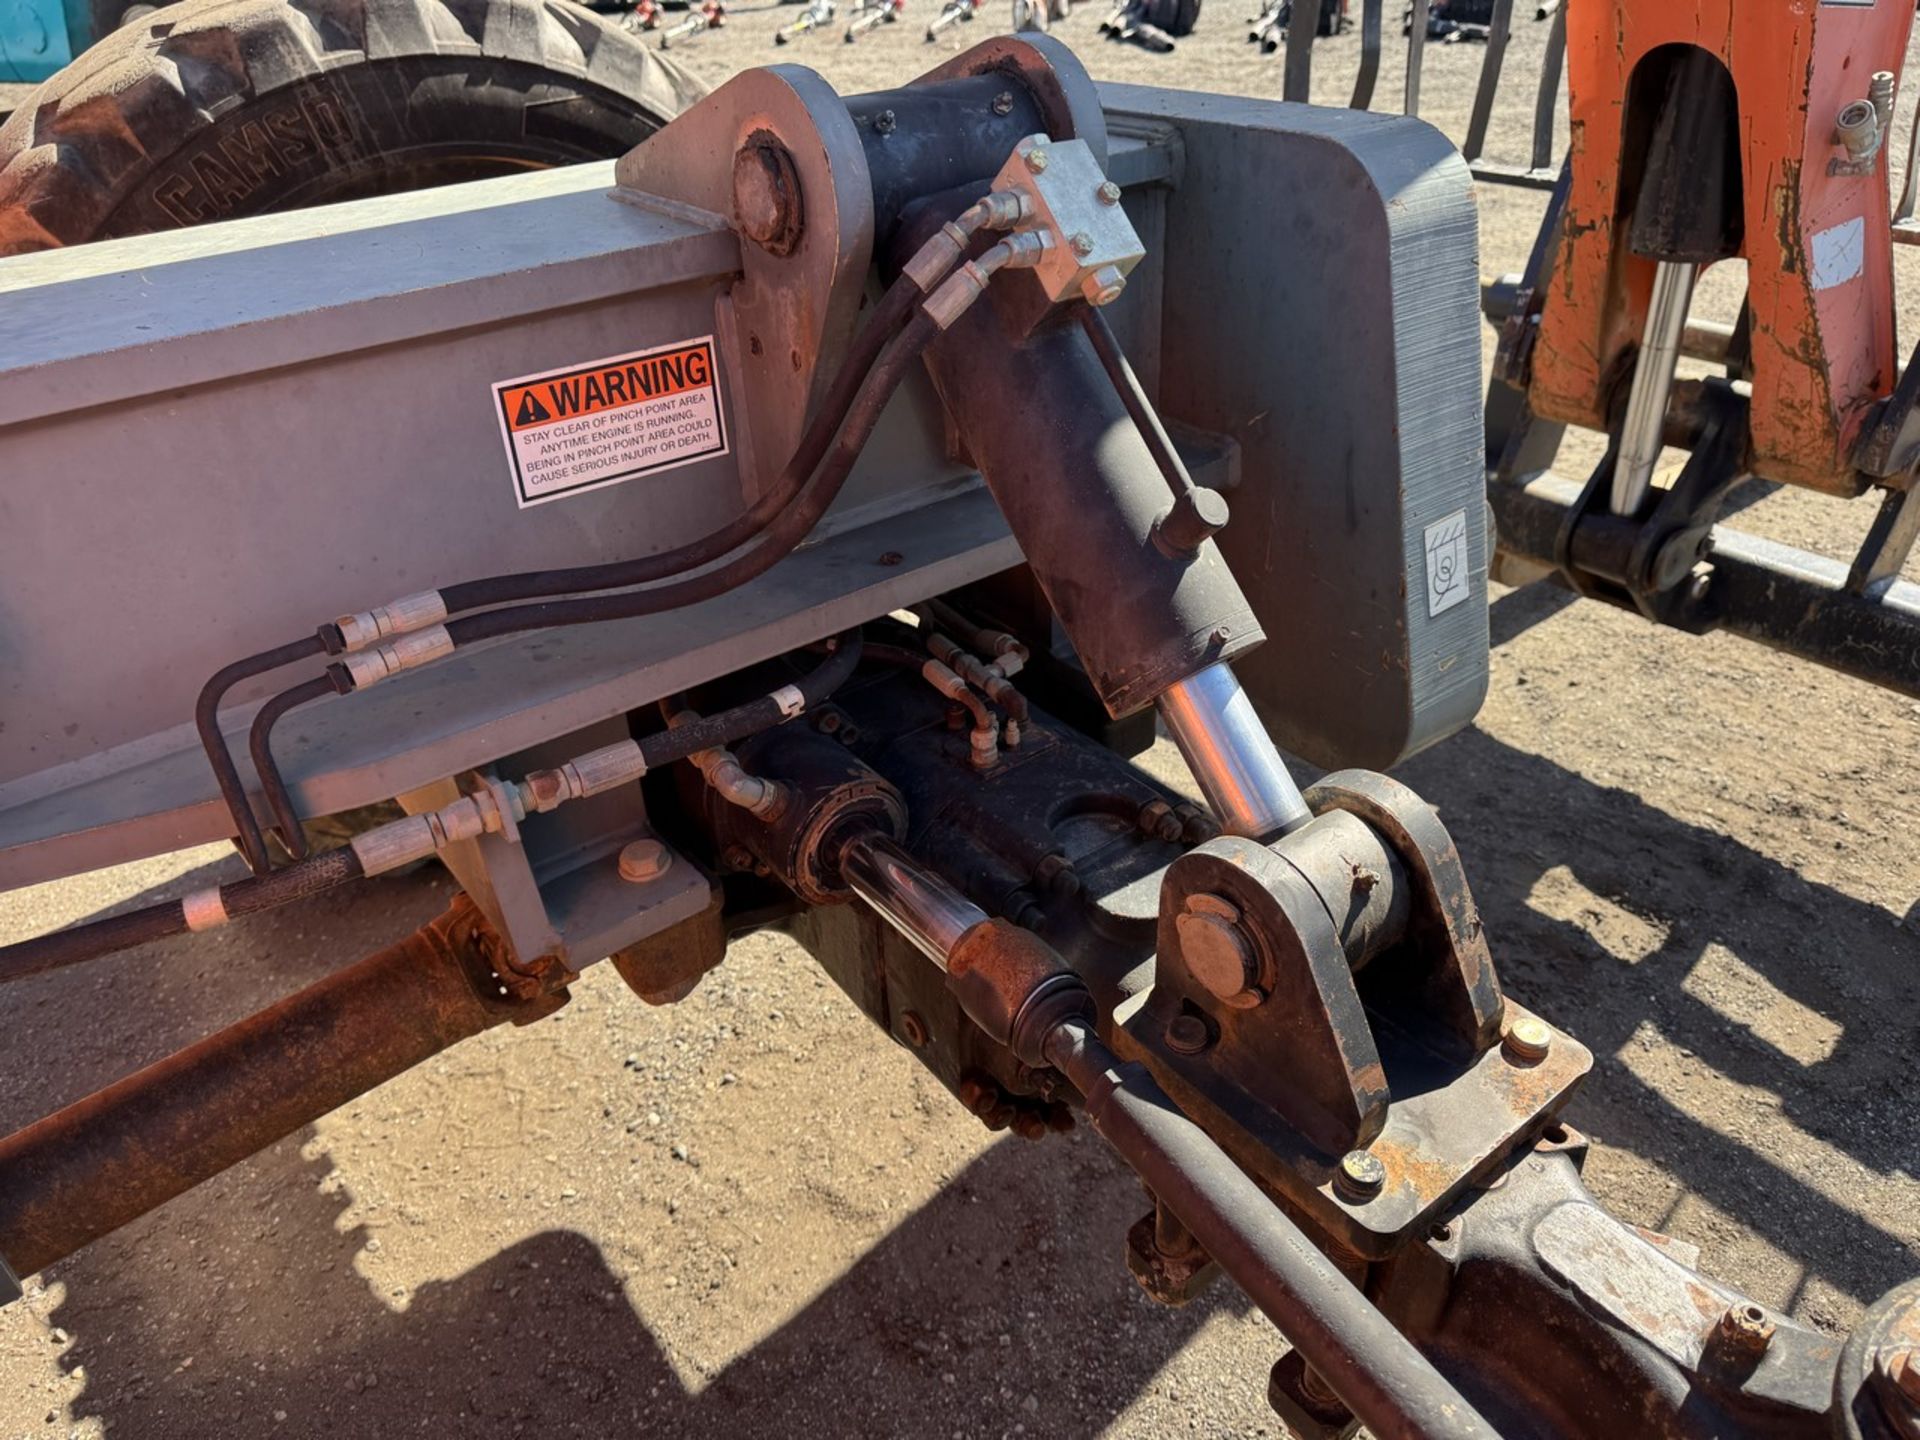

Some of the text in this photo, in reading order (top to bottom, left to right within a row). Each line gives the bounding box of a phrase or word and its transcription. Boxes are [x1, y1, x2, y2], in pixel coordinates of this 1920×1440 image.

[152, 89, 353, 226] CAMSO
[549, 353, 707, 416] WARNING
[524, 394, 706, 445] STAY CLEAR OF PINCH POINT AREA
[527, 418, 712, 472] BEING IN PINCH POINT AREA COULD
[541, 410, 696, 453] ANYTIME ENGINE IS RUNNING.
[531, 468, 569, 485] CAUSE
[572, 456, 619, 474] SERIOUS
[621, 445, 657, 462] INJURY
[660, 441, 675, 451] OR
[678, 432, 712, 447] DEATH.
